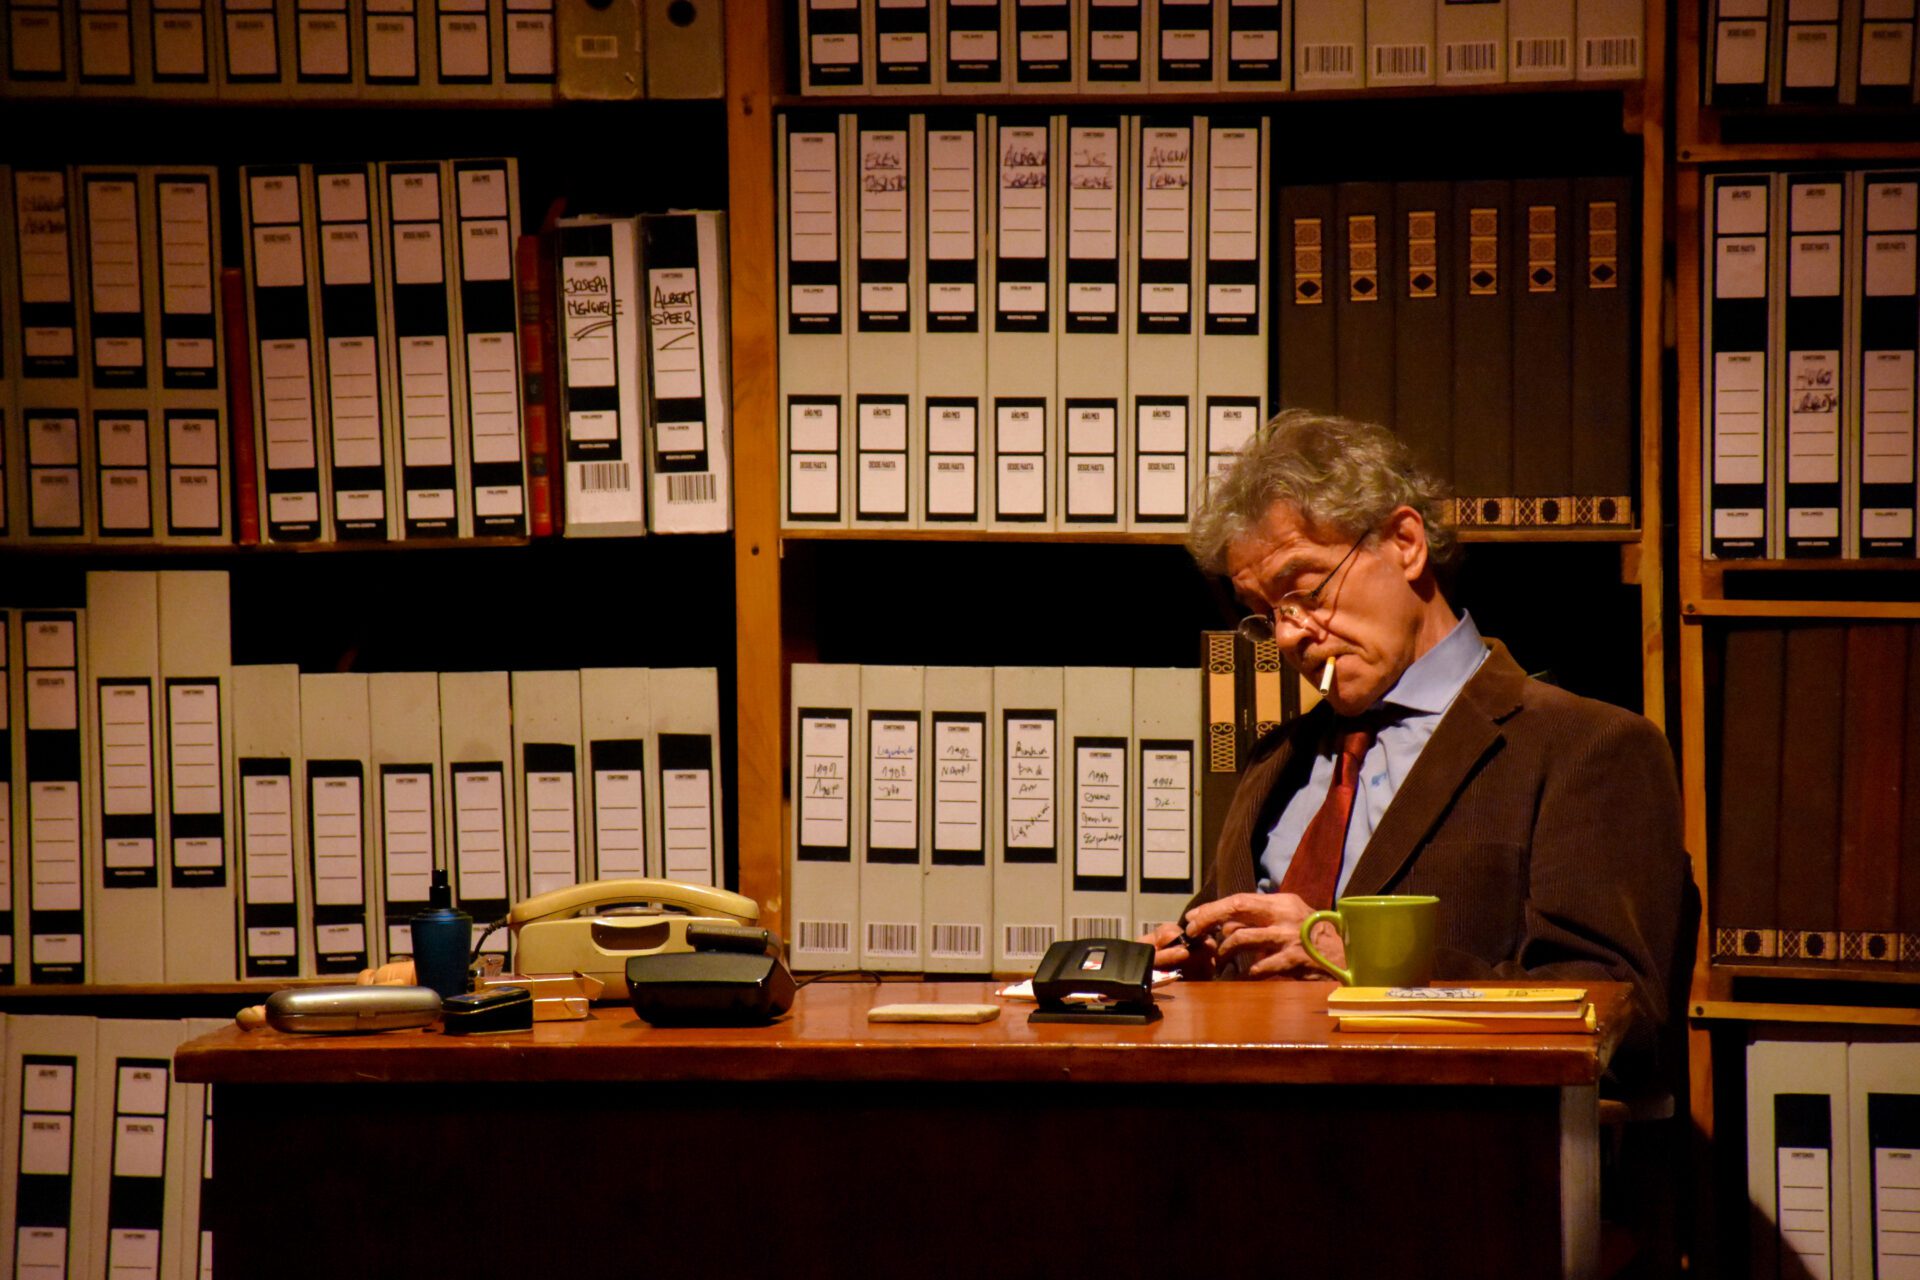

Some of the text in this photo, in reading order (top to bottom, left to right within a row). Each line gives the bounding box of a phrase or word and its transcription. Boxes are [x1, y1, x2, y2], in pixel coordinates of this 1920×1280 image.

[565, 275, 608, 293] JOSEPH
[654, 286, 695, 309] ALBERT
[652, 312, 696, 326] SPEER
